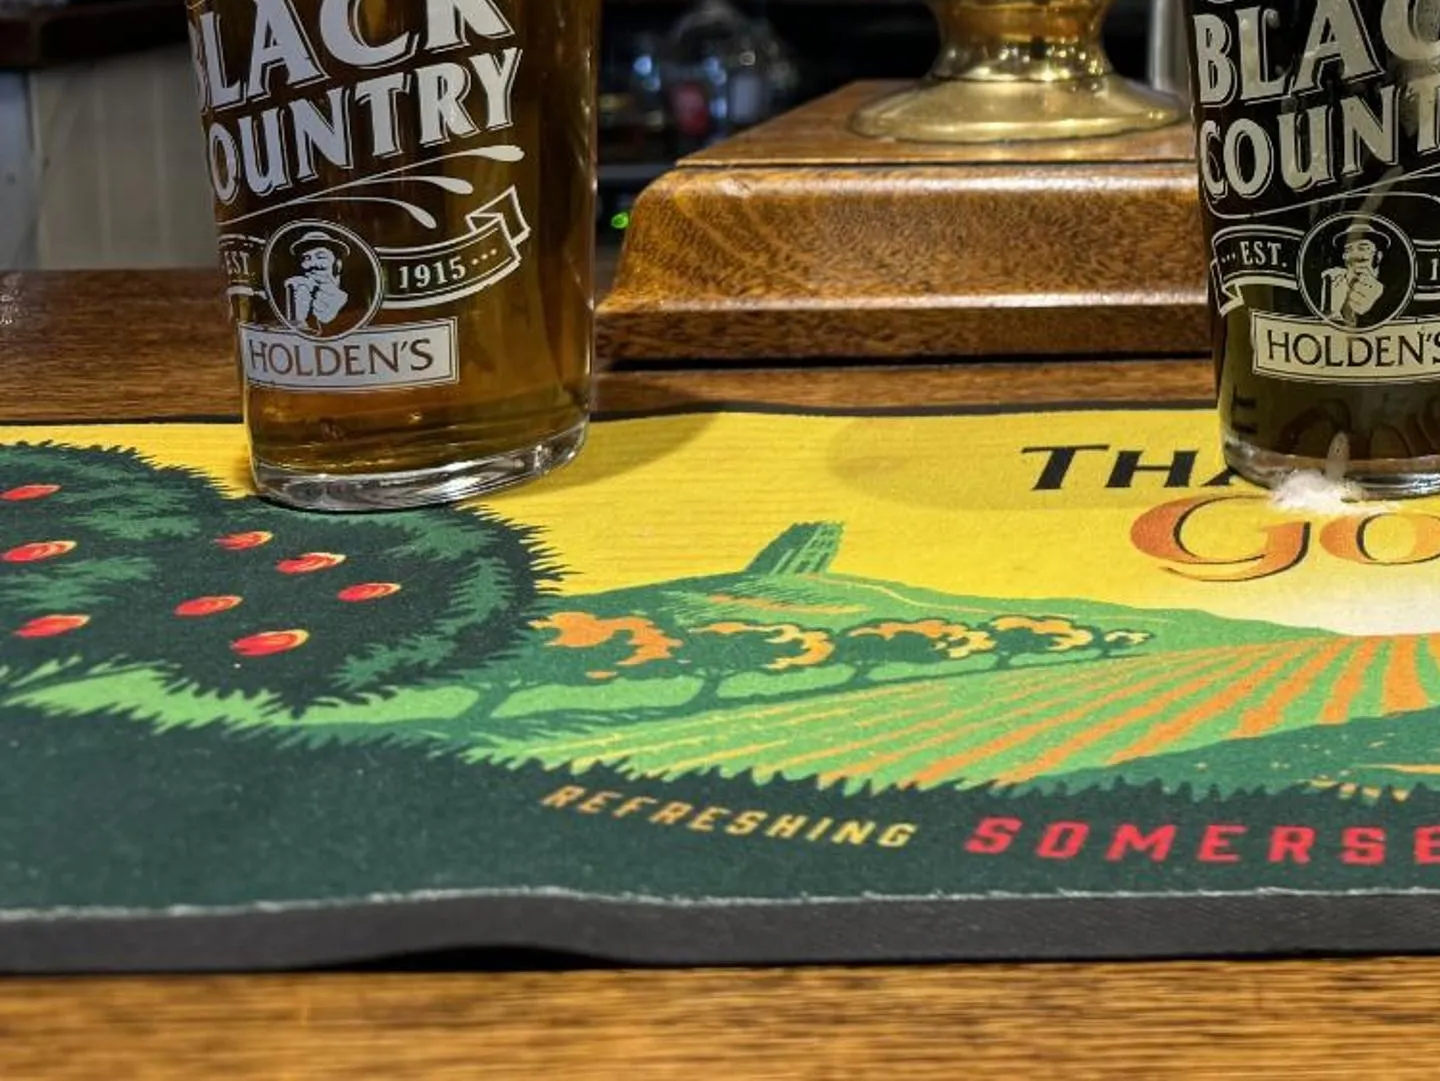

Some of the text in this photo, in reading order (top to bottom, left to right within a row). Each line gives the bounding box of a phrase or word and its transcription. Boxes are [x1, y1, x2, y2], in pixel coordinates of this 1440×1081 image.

[206, 48, 523, 205] OUNTRY
[250, 338, 434, 377] HOLDEN'S
[541, 784, 918, 850] REFRESHING
